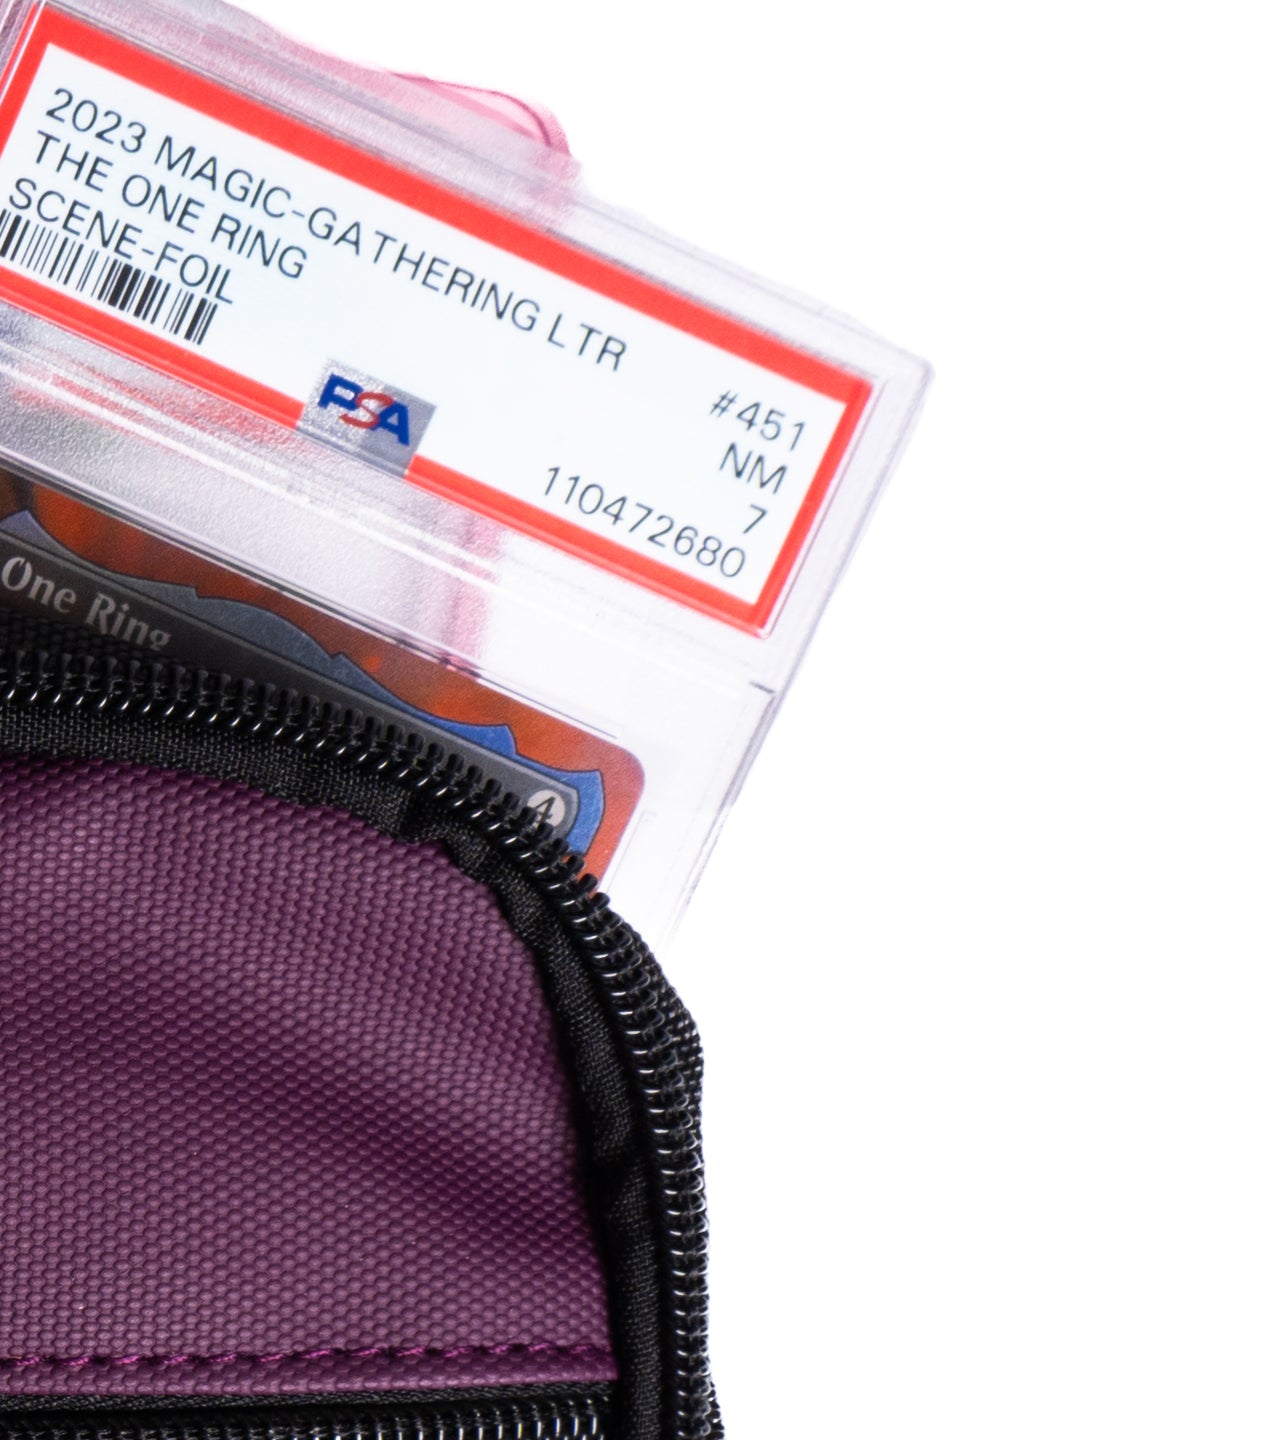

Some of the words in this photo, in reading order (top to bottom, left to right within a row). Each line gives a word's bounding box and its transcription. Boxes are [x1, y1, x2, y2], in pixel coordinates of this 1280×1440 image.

[9, 177, 233, 304] SCENE-FOIL
[36, 130, 113, 192] THE
[122, 174, 205, 233] ONE
[211, 213, 307, 279] RING
[45, 87, 147, 154] 2023
[154, 134, 541, 332] MAGIC-GATHERING
[547, 313, 627, 372] LTR
[318, 373, 410, 445] PSA
[710, 390, 806, 451] #451
[719, 442, 788, 494] NM
[544, 466, 745, 578] 110472680
[743, 504, 768, 534] 7
[1, 556, 77, 613] One
[85, 592, 172, 651] Ring
